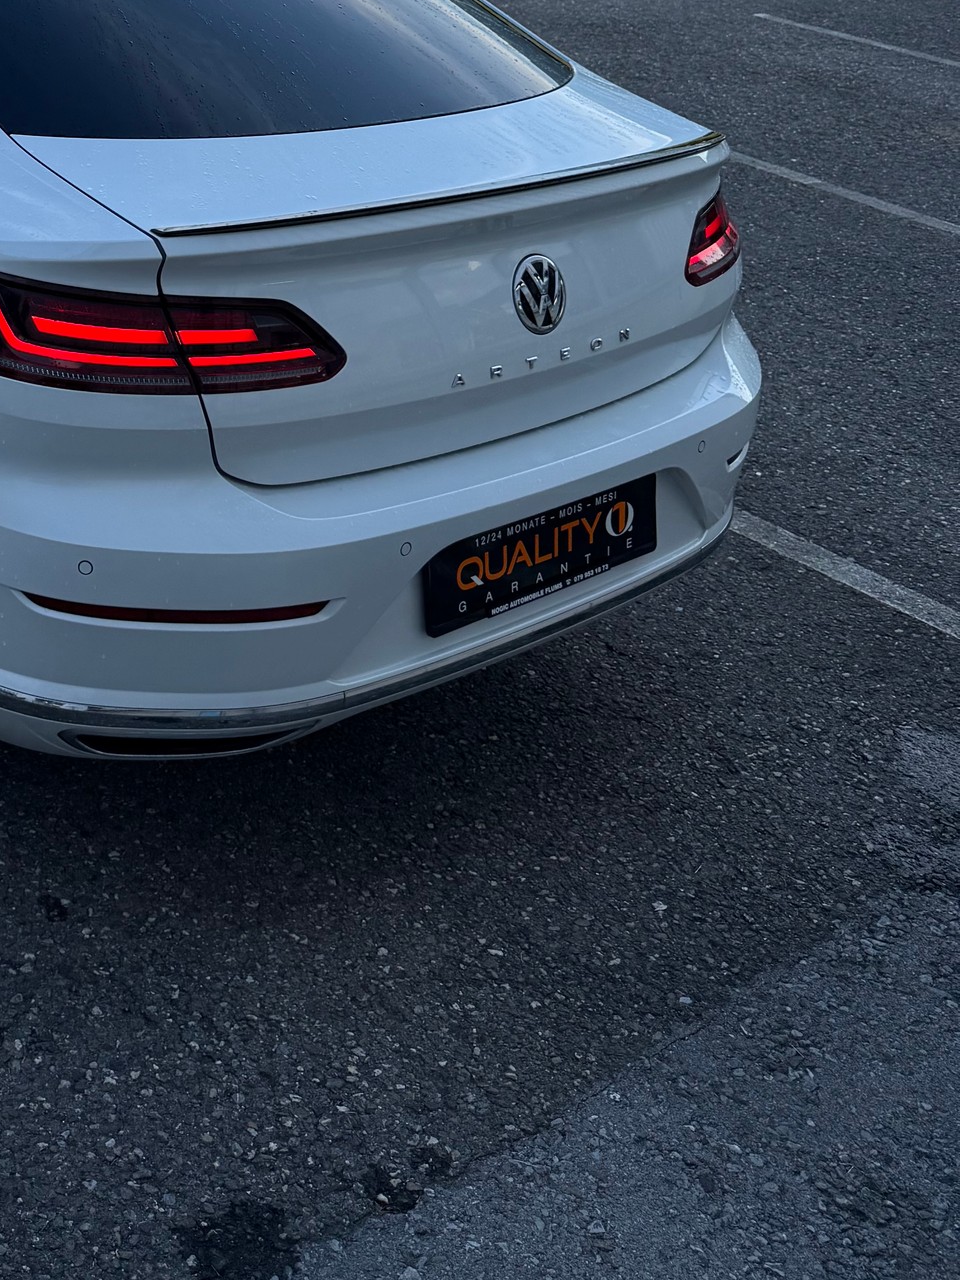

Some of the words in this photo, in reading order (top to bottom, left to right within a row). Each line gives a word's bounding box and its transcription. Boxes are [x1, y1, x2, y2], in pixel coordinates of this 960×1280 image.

[512, 253, 566, 335] VW
[451, 328, 630, 388] ARTEON
[456, 511, 602, 591] QUALITY
[475, 530, 502, 548] 12/24
[506, 515, 546, 537] MONATE
[559, 503, 582, 519] MOIS
[595, 491, 617, 506] MESI
[458, 537, 633, 613] GARANTIE
[510, 589, 544, 609] AUTOMOBILE
[545, 582, 563, 596] FLUMS
[573, 573, 584, 583] 079
